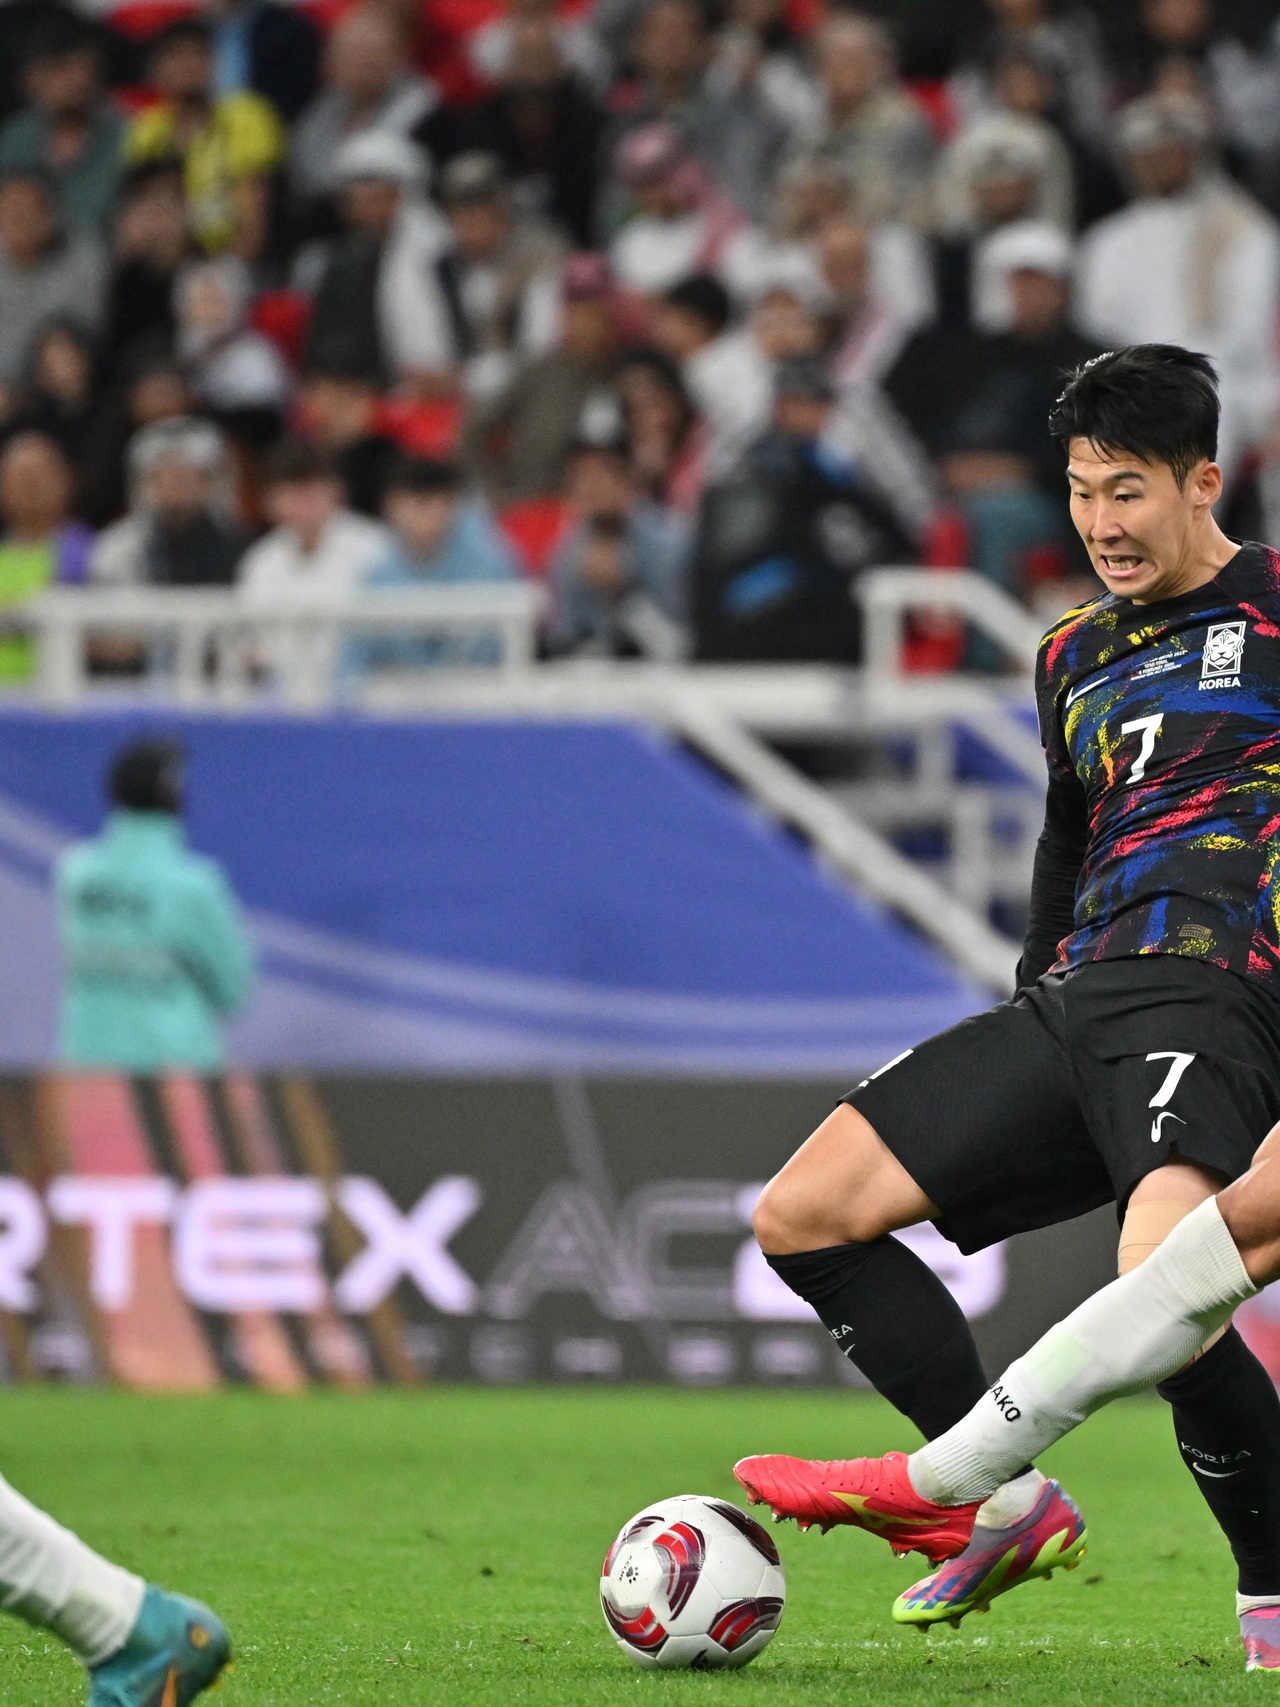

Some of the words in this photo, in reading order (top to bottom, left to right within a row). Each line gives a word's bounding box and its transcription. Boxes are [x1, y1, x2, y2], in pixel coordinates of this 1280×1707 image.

[1198, 676, 1241, 691] KOREA
[1122, 713, 1164, 785] 7
[1146, 1052, 1196, 1108] 7
[990, 1379, 1021, 1422] AKO
[1181, 1441, 1252, 1464] KOREA
